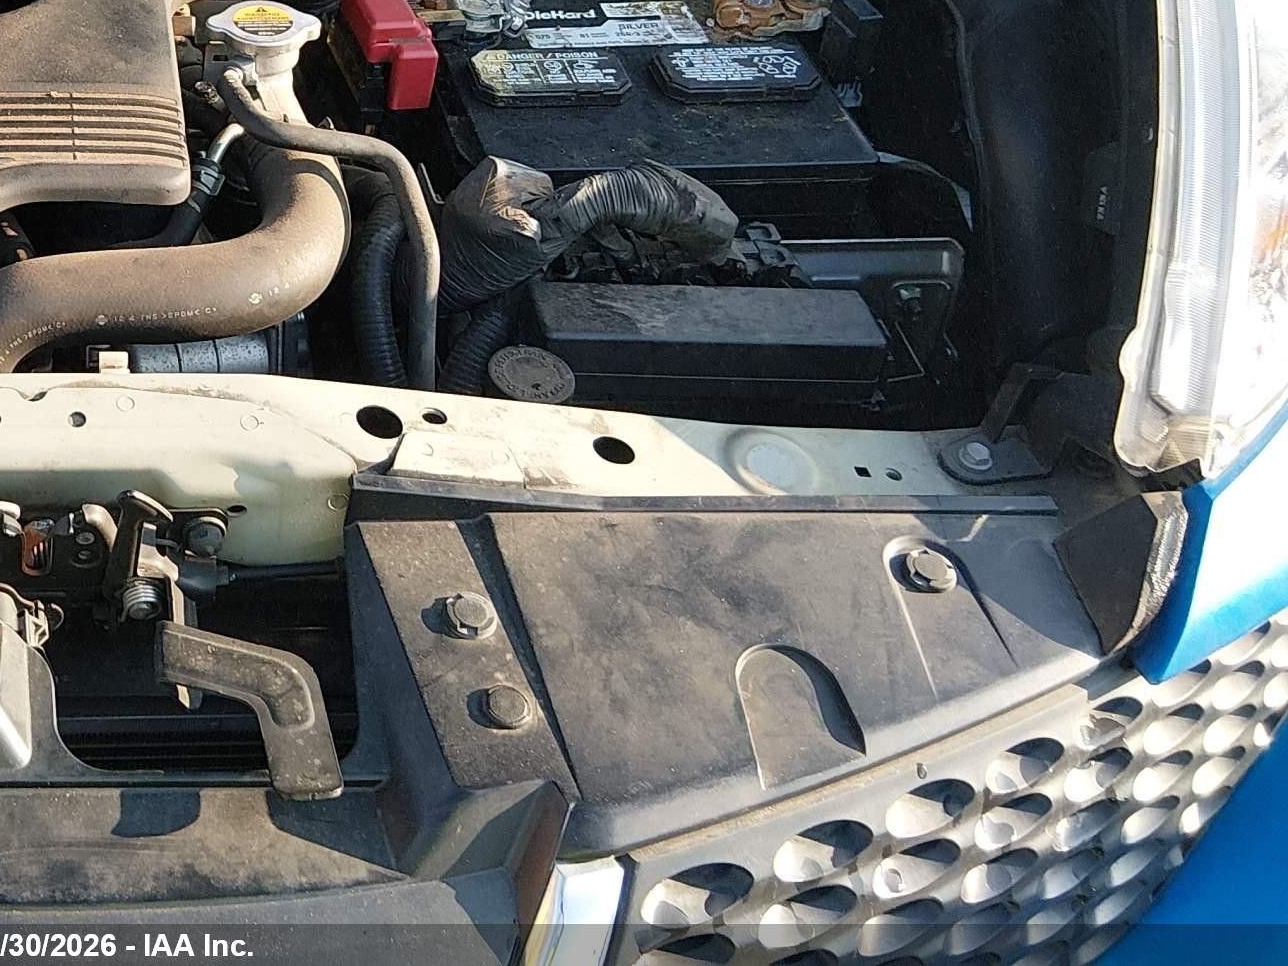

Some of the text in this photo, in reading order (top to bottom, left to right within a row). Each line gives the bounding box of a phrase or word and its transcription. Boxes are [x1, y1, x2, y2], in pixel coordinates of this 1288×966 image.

[524, 9, 596, 21] DieHard
[618, 22, 659, 30] SILVER
[497, 52, 544, 60] DANGER
[557, 51, 599, 59] POISON
